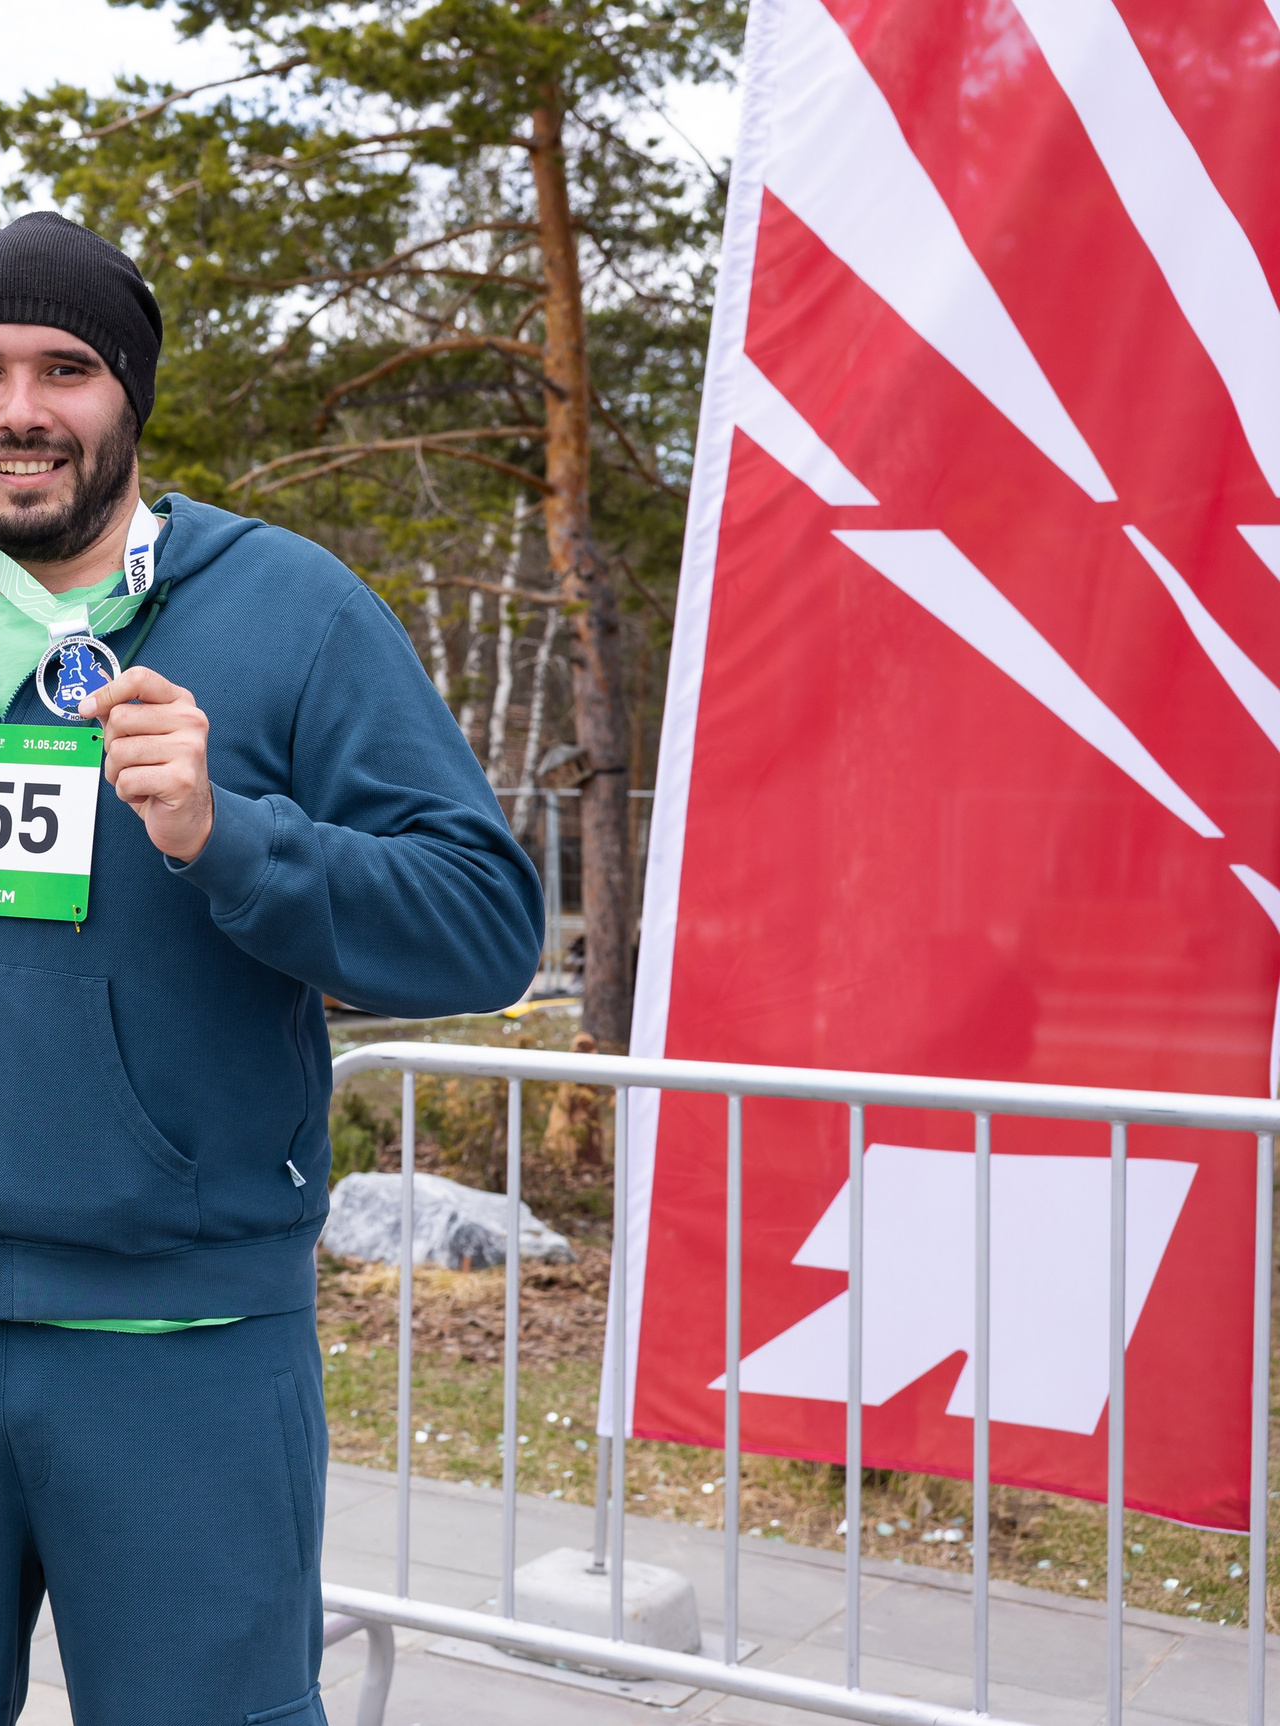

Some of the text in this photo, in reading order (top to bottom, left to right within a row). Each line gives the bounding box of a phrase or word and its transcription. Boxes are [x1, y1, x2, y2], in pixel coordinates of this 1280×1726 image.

[130, 555, 147, 594] НОЯБ
[61, 686, 86, 701] 50
[23, 738, 78, 751] 31.05.2025
